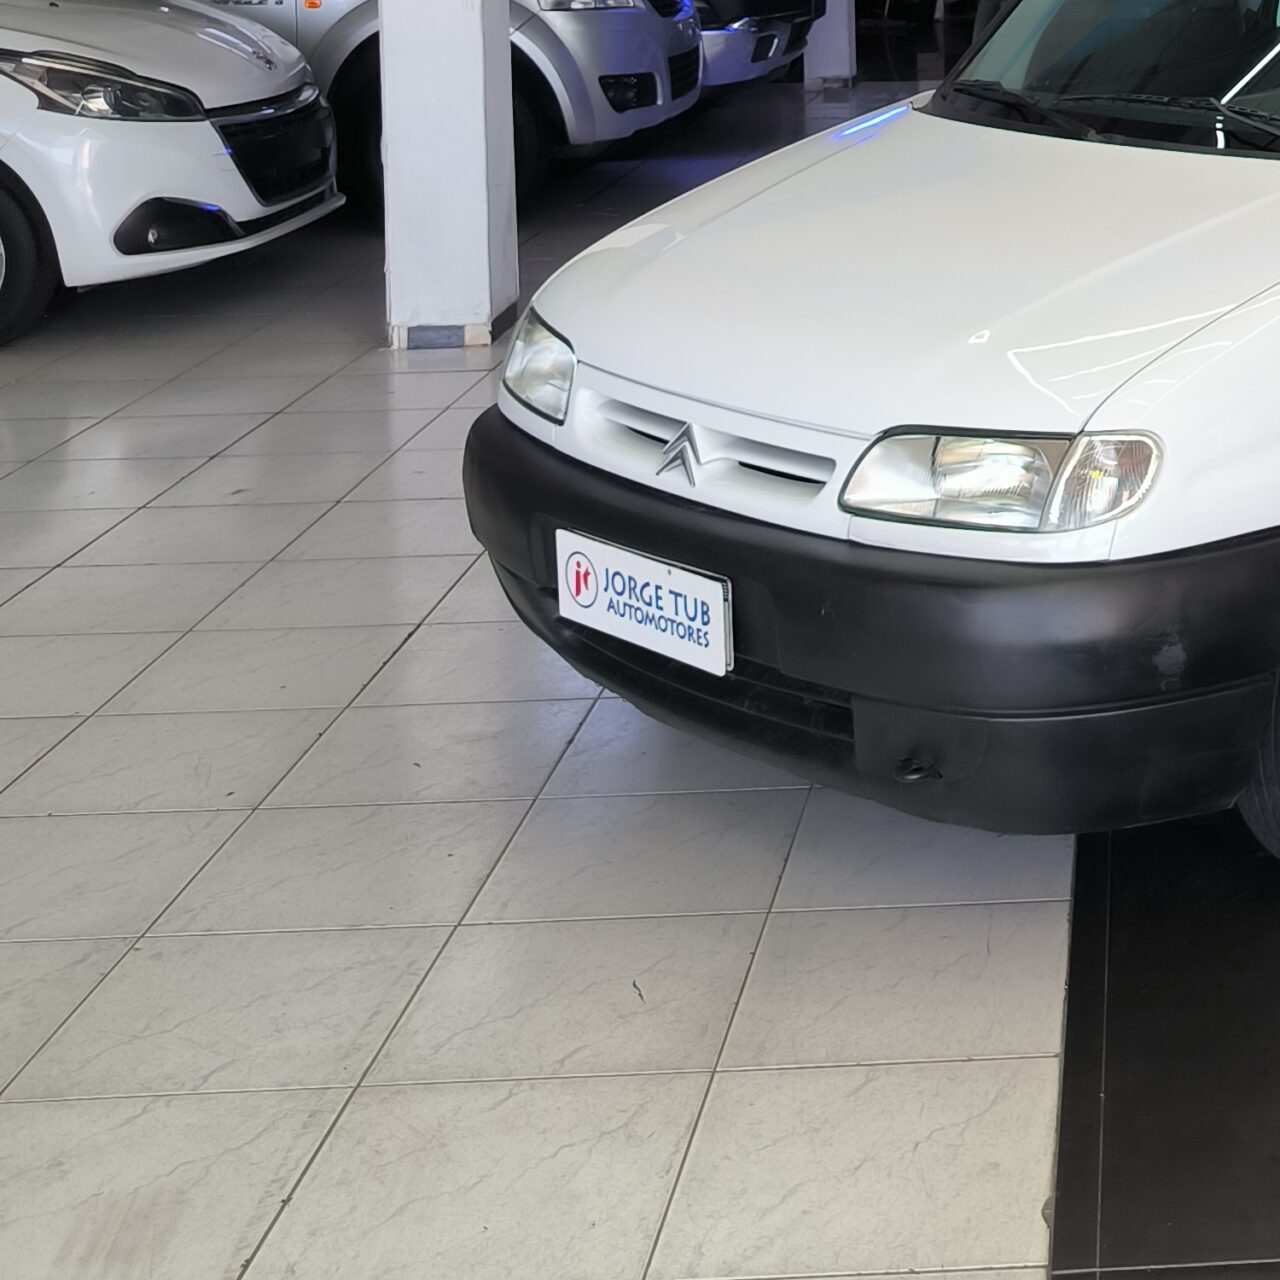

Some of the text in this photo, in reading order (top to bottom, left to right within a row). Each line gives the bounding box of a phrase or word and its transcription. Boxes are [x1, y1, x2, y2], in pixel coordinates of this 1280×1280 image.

[603, 568, 711, 626] JORGE TUB
[606, 597, 710, 649] AUTOMOTORES
